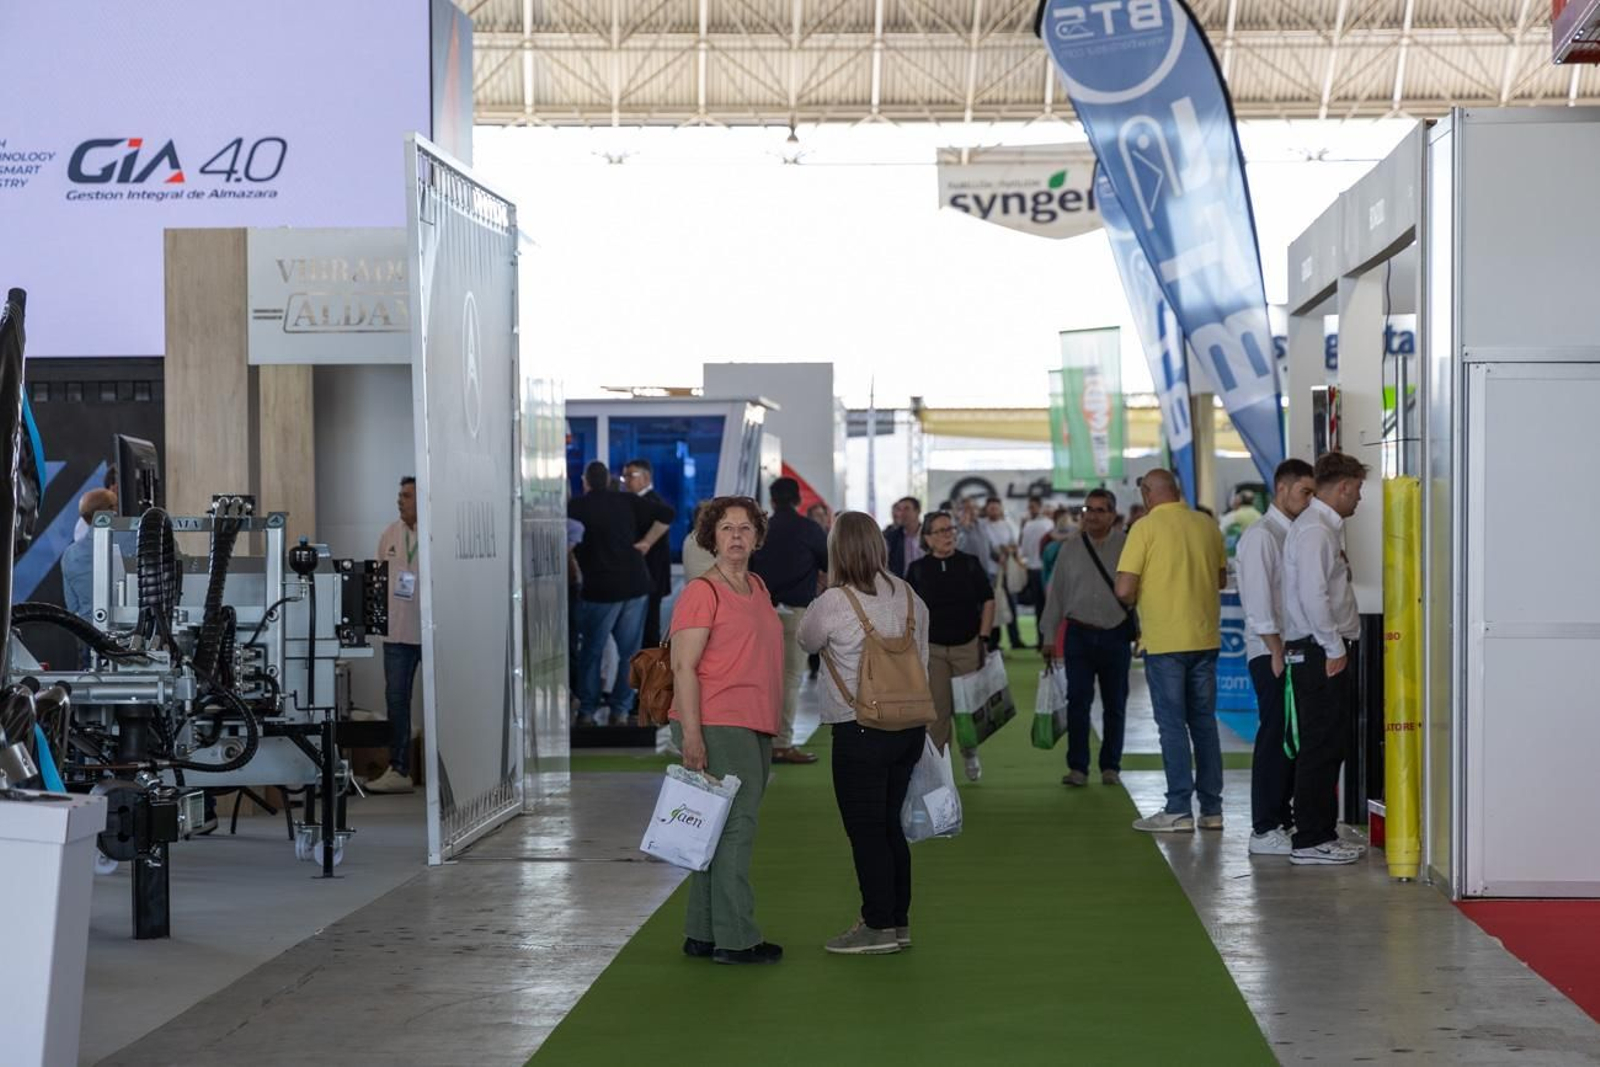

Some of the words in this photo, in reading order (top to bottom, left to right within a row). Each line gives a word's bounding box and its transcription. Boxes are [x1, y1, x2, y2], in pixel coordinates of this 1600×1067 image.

[198, 137, 288, 183] 4.0
[126, 189, 184, 202] Integral
[186, 189, 206, 199] de
[207, 188, 279, 199] Almazara
